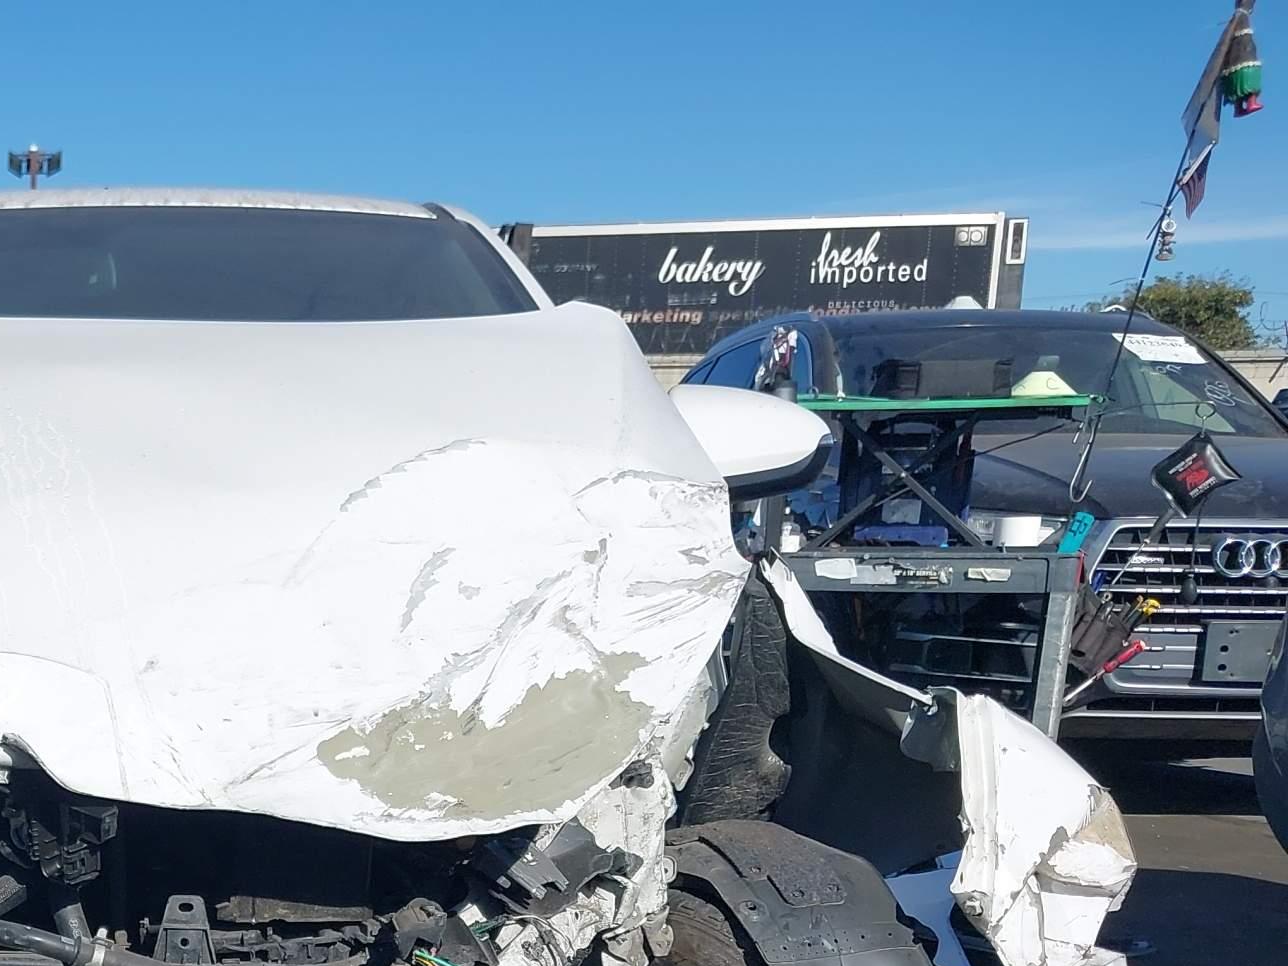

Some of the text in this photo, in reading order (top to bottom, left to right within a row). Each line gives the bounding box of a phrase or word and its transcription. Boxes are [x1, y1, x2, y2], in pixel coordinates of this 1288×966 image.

[658, 246, 767, 296] bakery
[810, 258, 928, 288] imported
[817, 231, 881, 283] fresh
[828, 300, 896, 309] DELICIOUS
